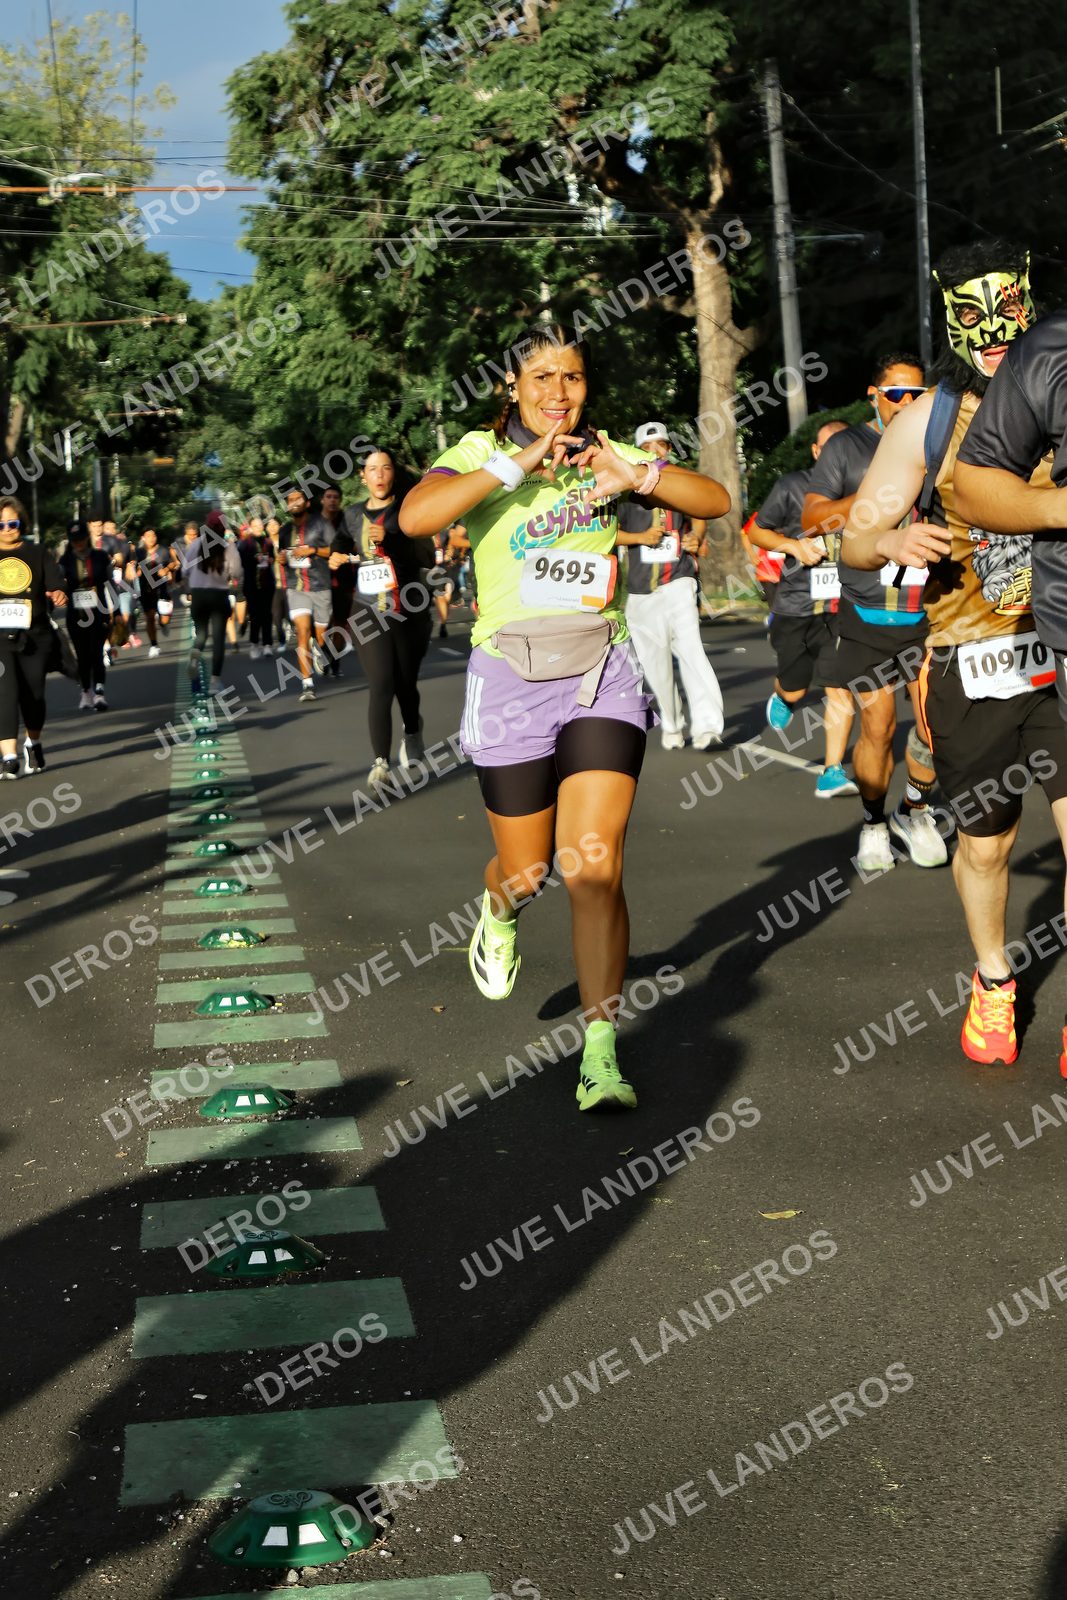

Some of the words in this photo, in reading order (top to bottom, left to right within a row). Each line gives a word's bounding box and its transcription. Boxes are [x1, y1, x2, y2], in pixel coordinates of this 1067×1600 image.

[360, 568, 391, 581] 12524
[535, 557, 596, 585] 9695
[964, 641, 1048, 679] 10970
